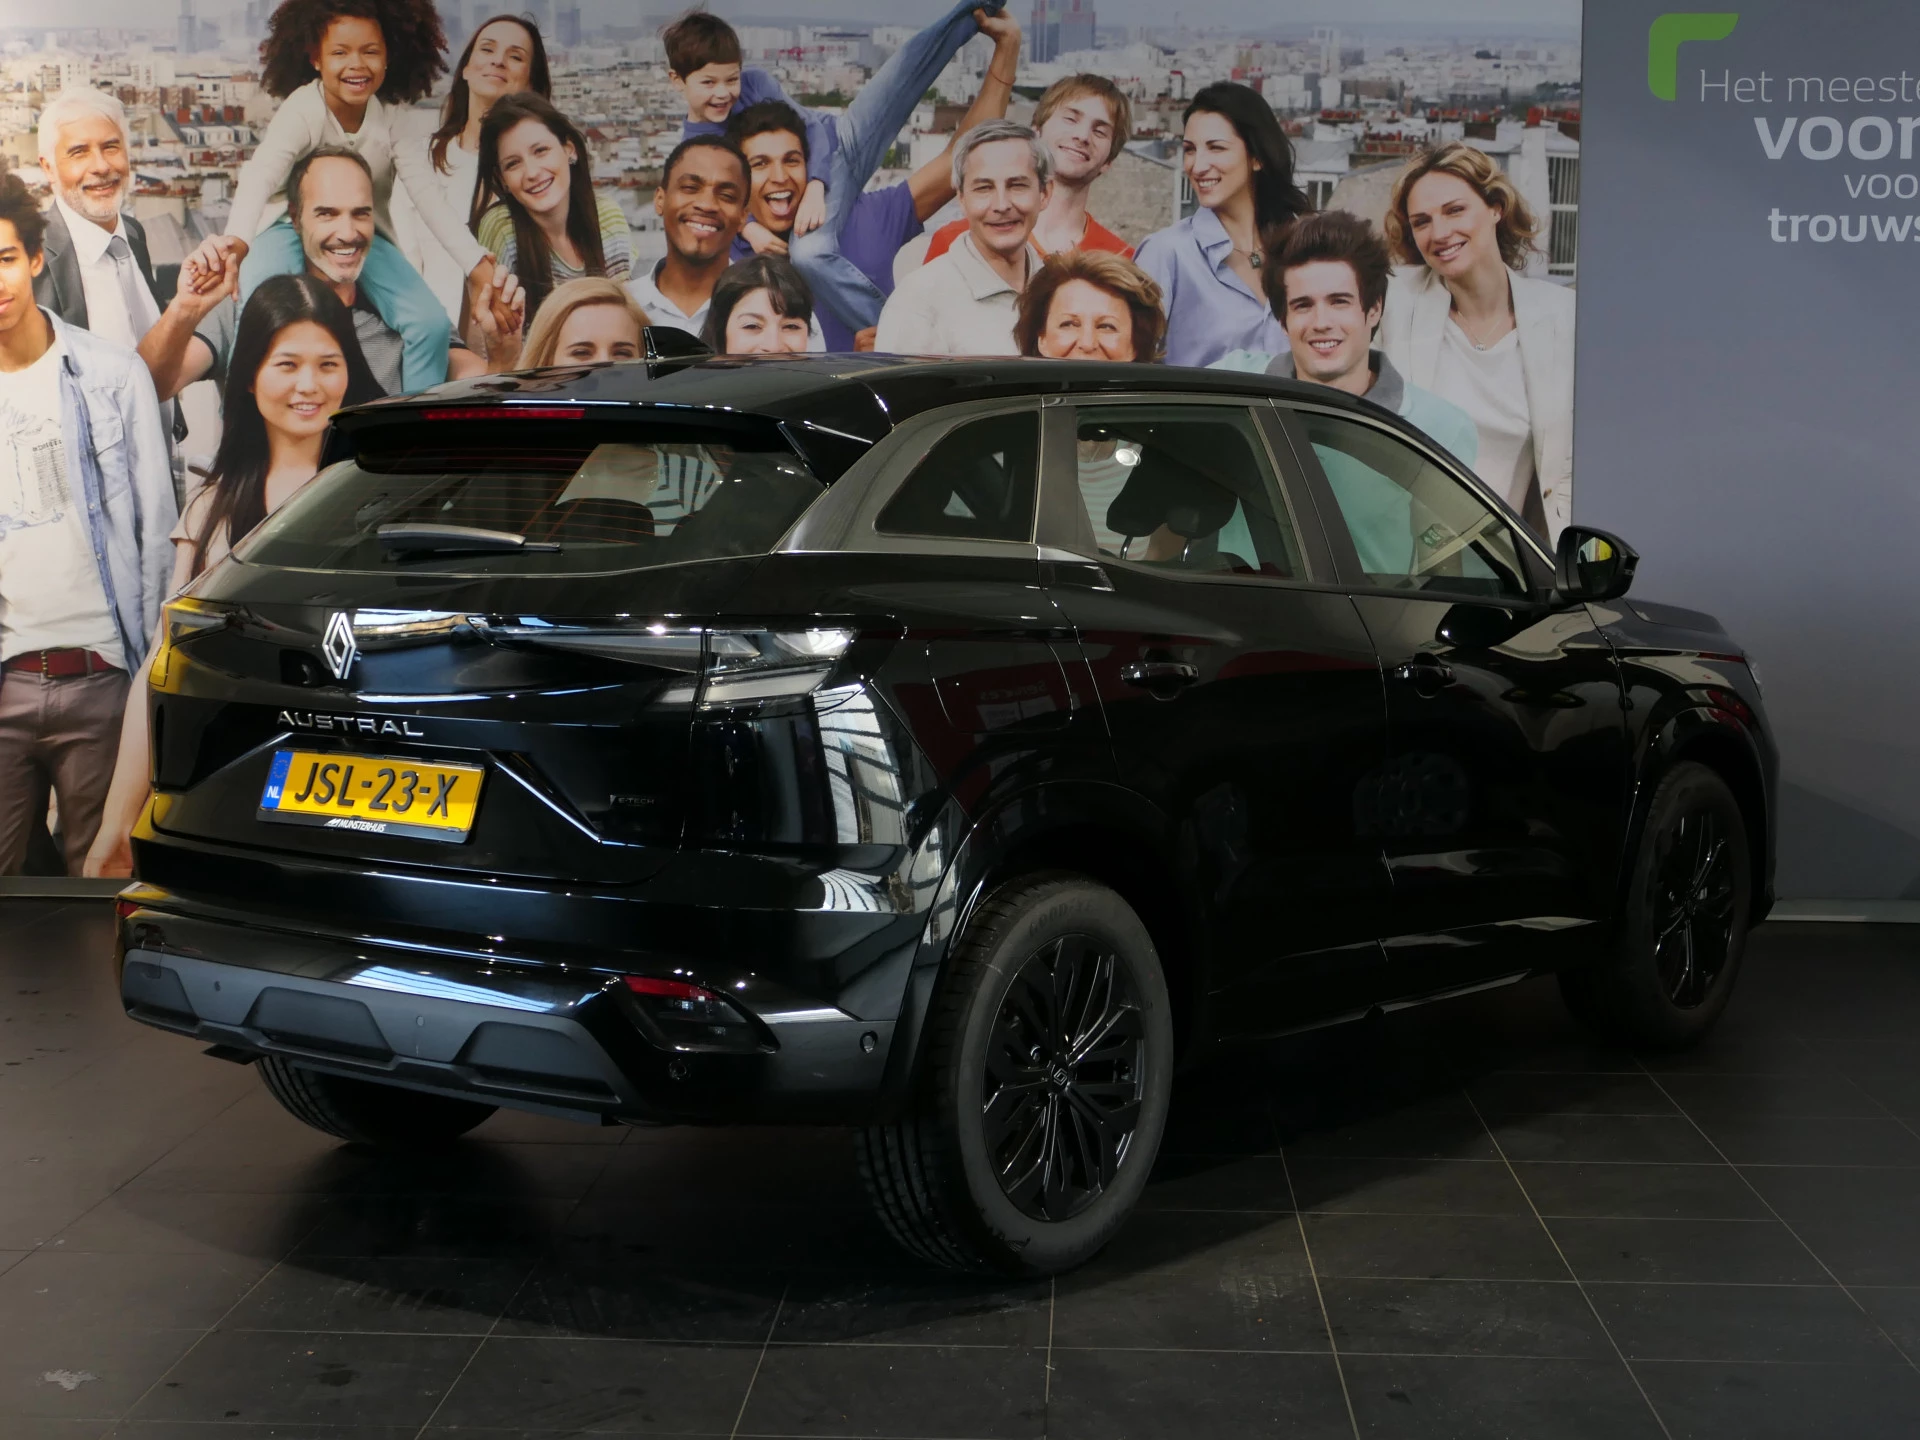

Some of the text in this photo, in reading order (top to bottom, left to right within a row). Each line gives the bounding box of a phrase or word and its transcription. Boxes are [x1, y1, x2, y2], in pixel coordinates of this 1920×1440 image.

[1700, 69, 1920, 102] Het meest
[1844, 174, 1919, 199] voo
[277, 710, 424, 737] AUSTRAL
[266, 786, 280, 799] NL
[294, 762, 459, 819] JSL-23-X
[336, 819, 387, 833] MUNSTERHUIS
